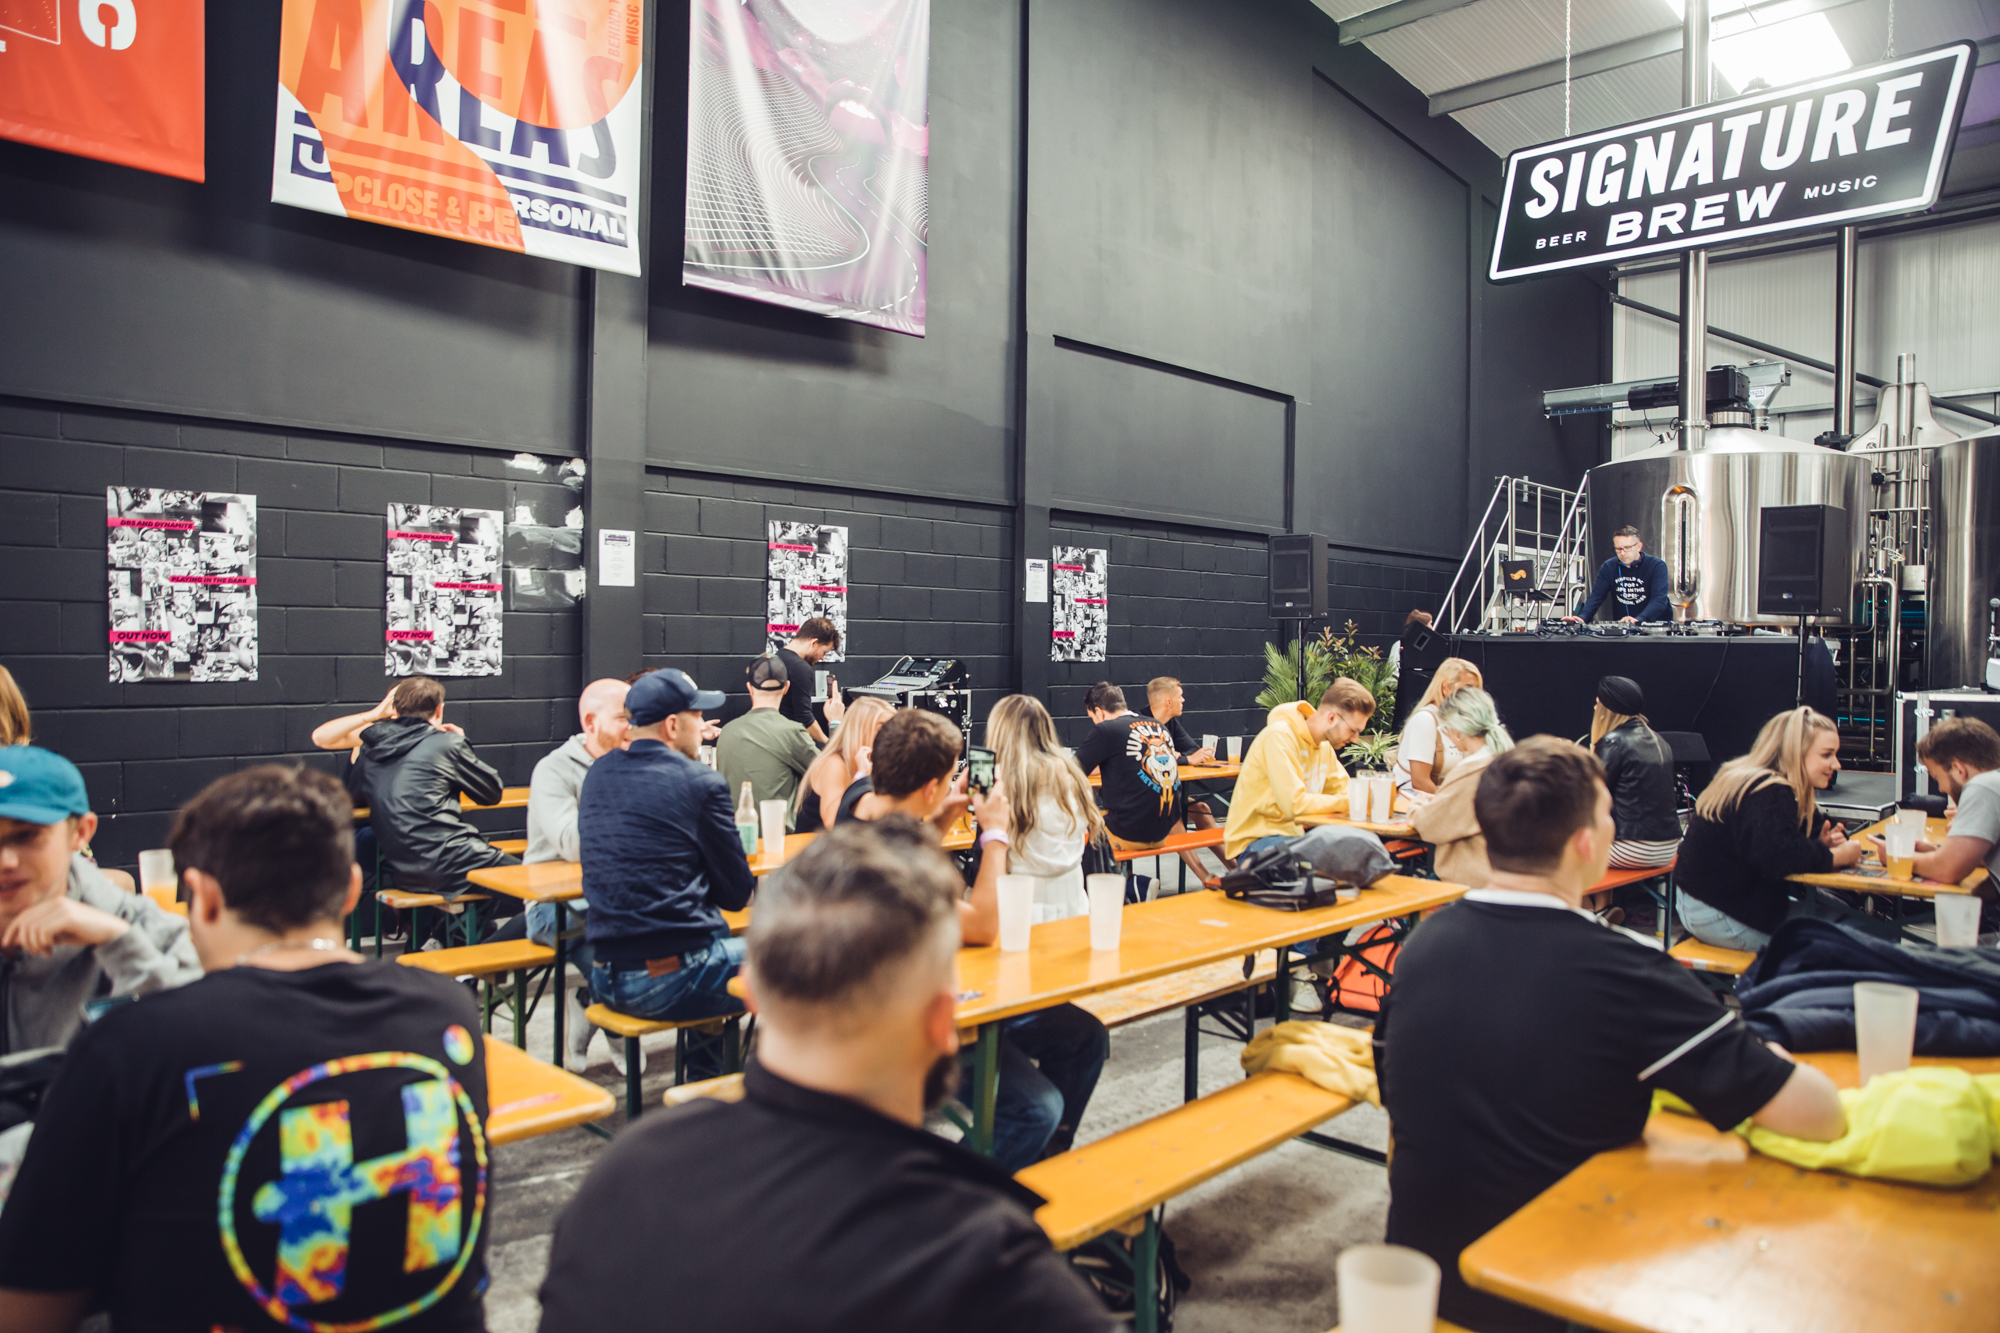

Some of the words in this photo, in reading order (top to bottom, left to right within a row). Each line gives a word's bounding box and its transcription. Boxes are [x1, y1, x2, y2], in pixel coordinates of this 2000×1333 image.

[608, 9, 621, 57] BEHIND
[626, 4, 640, 46] MUSIC
[296, 0, 624, 180] AREAS
[1524, 72, 1924, 219] SIGNATURE
[353, 175, 439, 219] CLOSE
[468, 193, 626, 241] PERSONAL
[1535, 230, 1587, 249] BEER
[1605, 182, 1786, 246] BREW
[1803, 175, 1878, 200] MUSIC
[154, 521, 193, 529] DYNAMITE
[117, 632, 140, 640] OUT
[141, 632, 169, 640] NOW
[254, 1078, 463, 1307] H
